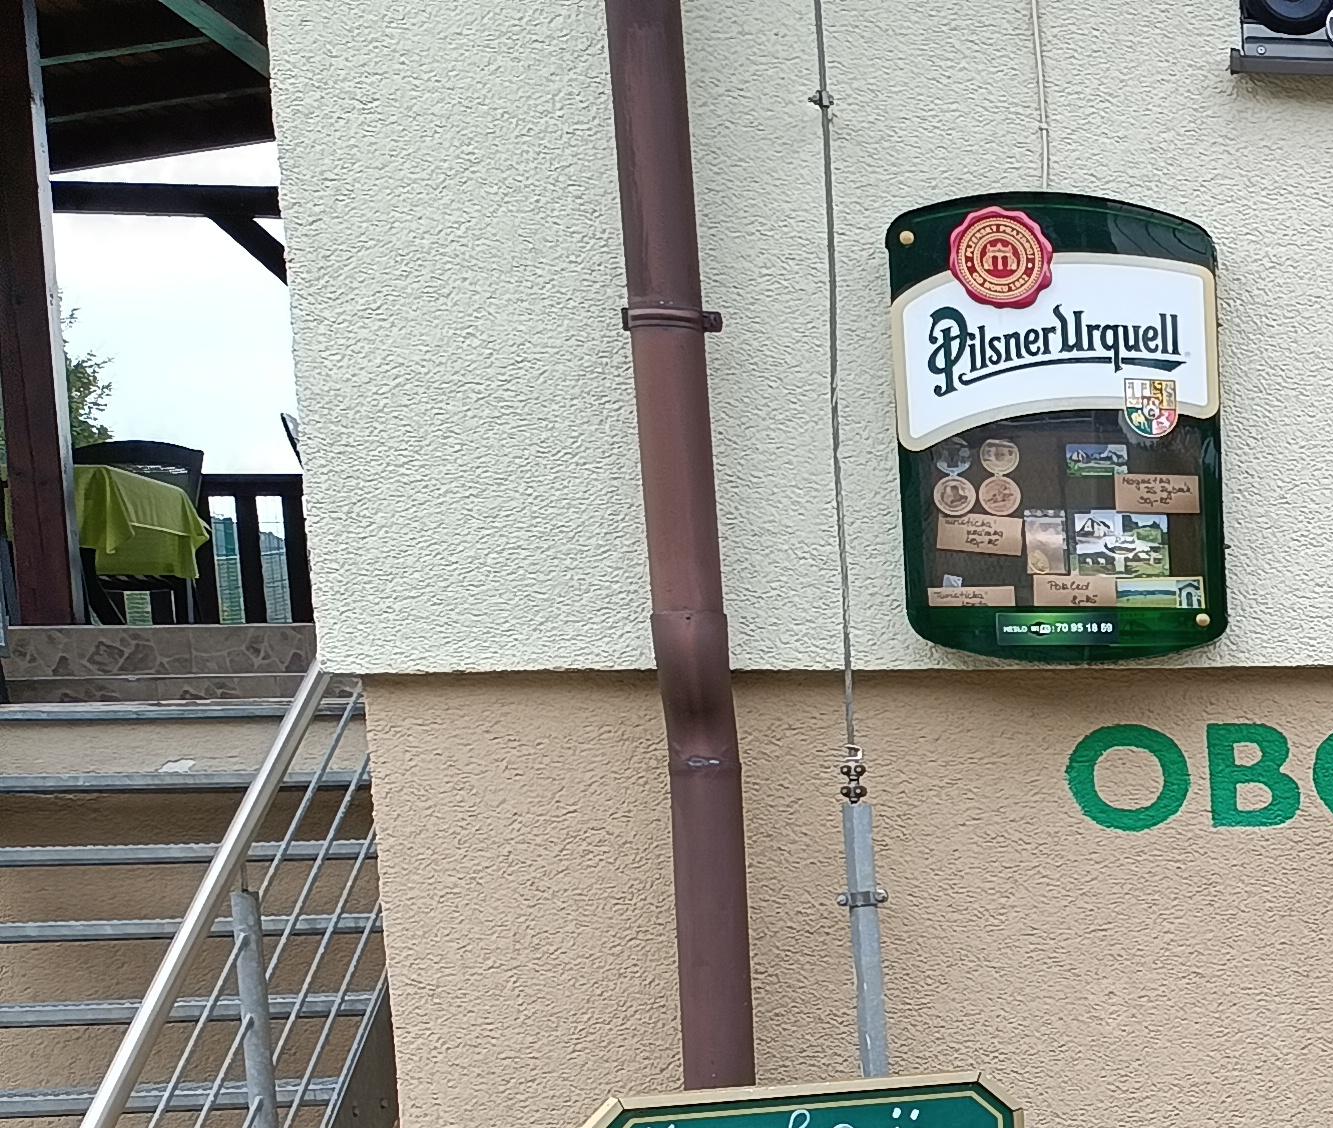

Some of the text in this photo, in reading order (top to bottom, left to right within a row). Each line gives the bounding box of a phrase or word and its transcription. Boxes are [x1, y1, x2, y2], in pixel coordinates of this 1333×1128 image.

[927, 303, 1182, 398] Pilsner Urquell
[1055, 622, 1069, 633] 70
